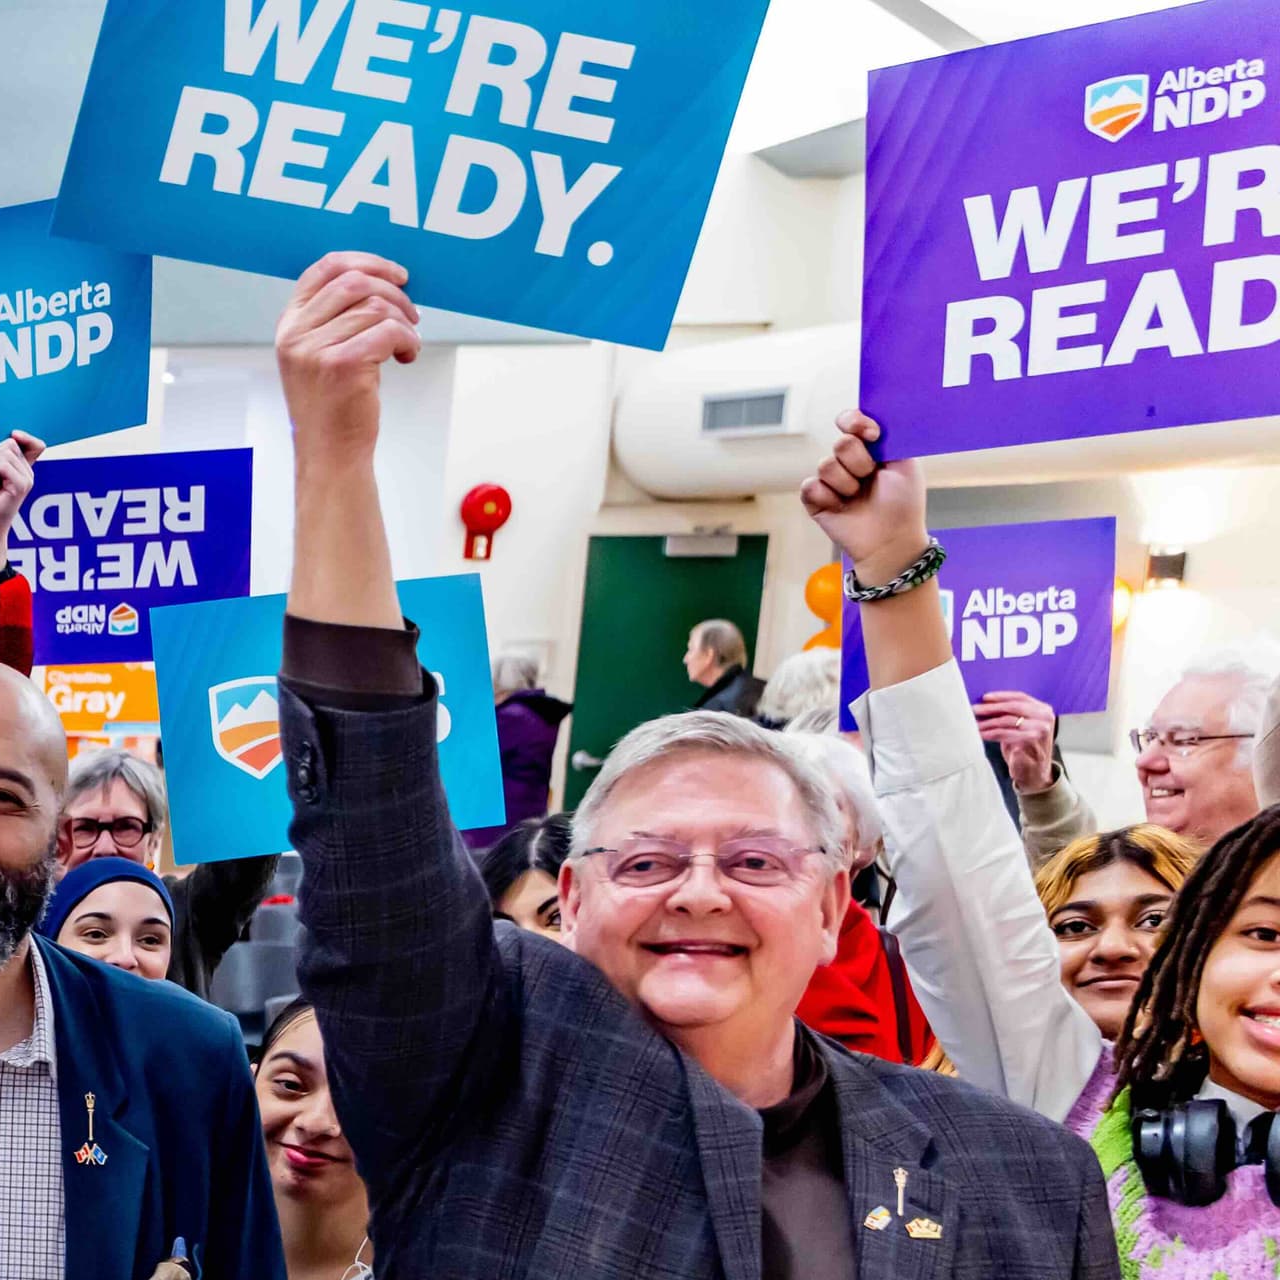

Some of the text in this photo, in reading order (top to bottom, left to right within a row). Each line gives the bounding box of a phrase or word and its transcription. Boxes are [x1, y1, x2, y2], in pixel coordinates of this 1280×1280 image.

[224, 0, 636, 144] WE'RE
[1155, 58, 1265, 95] Alberta
[1152, 78, 1267, 132] NDP
[159, 86, 622, 266] READY.
[962, 145, 1280, 281] WE'R
[942, 254, 1280, 388] READ
[7, 540, 198, 592] WE'RE
[55, 604, 106, 624] NDP
[962, 586, 1077, 617] Alberta
[56, 622, 105, 635] Alberta
[961, 611, 1078, 662] NDP
[46, 684, 126, 719] Gray
